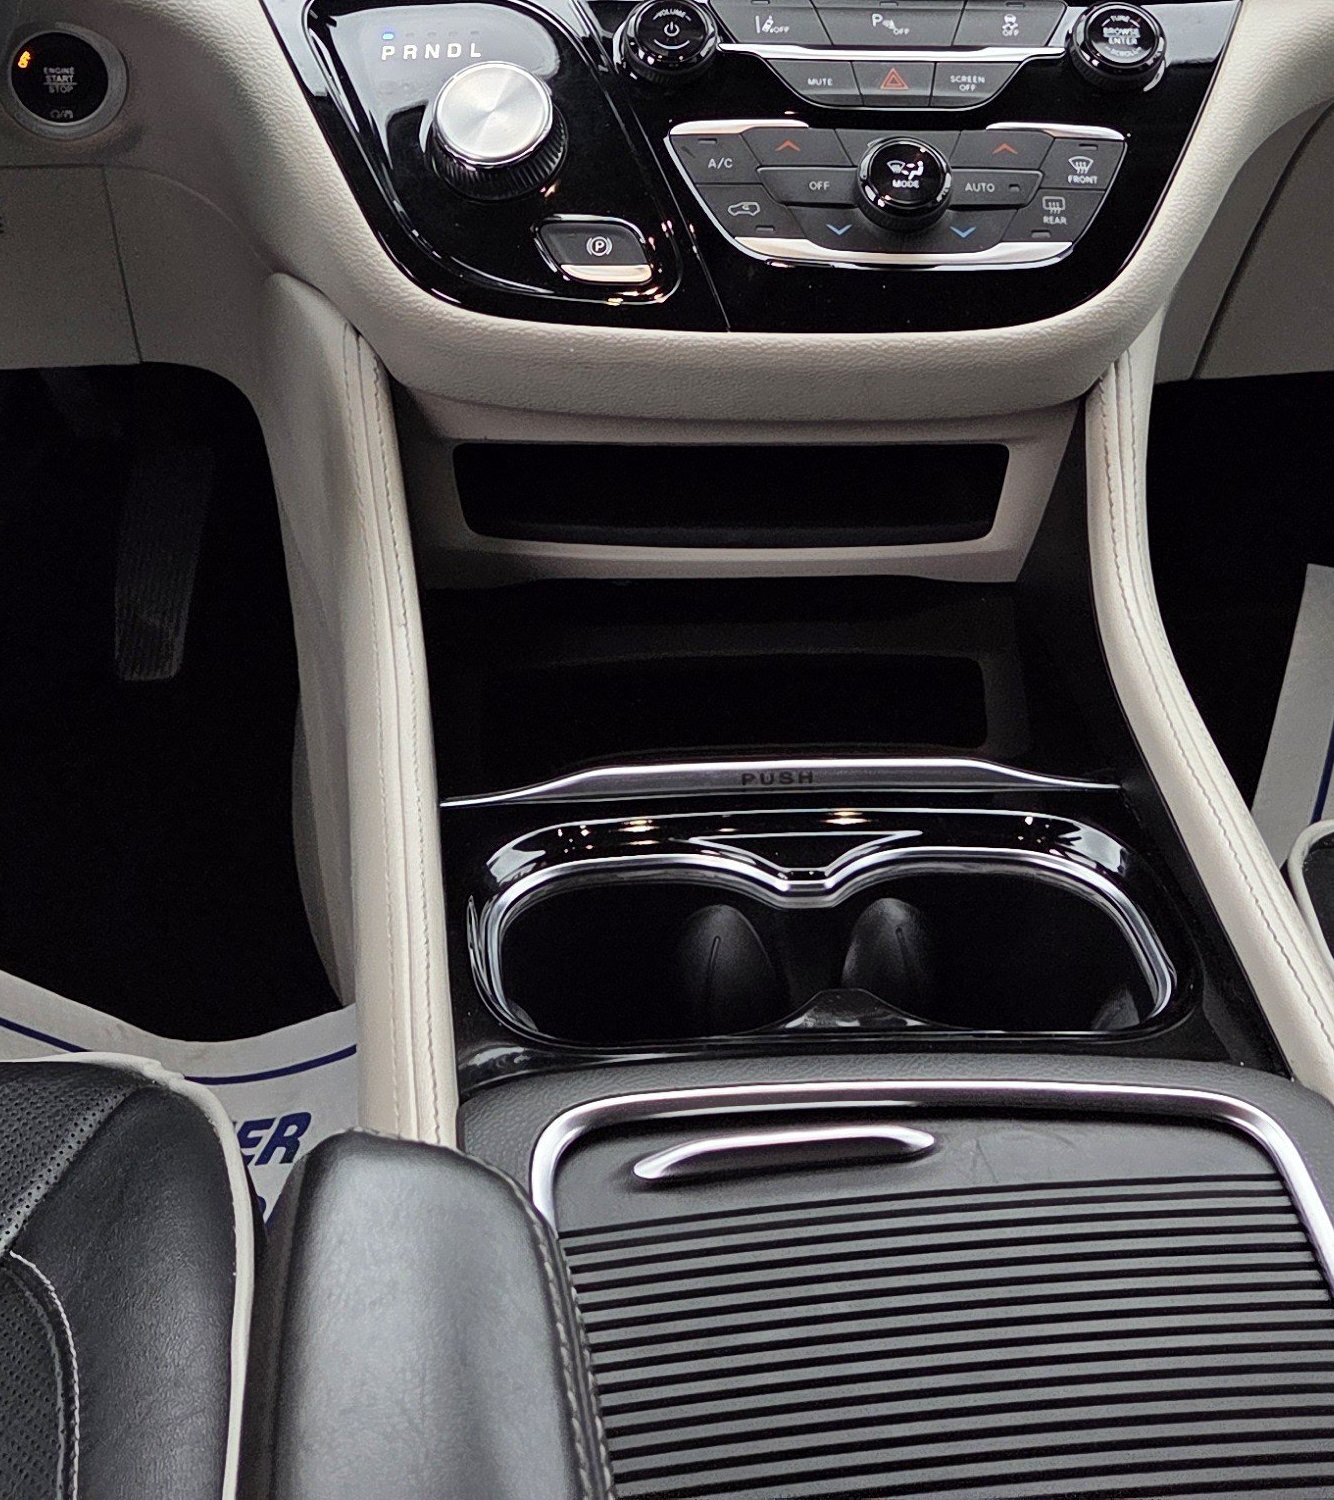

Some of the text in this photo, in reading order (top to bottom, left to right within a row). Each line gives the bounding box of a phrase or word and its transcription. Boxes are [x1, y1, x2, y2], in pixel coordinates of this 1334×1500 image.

[43, 66, 75, 75] ENGINE
[45, 75, 74, 83] START
[807, 78, 834, 87] MUTE
[949, 74, 986, 84] SCREEN
[49, 84, 74, 94] STOP
[958, 84, 976, 92] OFF
[707, 157, 733, 169] A/C
[891, 178, 920, 189] MODE
[1067, 174, 1098, 185] FRONT
[808, 180, 830, 191] OFF
[965, 182, 996, 193] AUTO
[1042, 215, 1067, 225] REAR
[741, 769, 814, 786] PUSH
